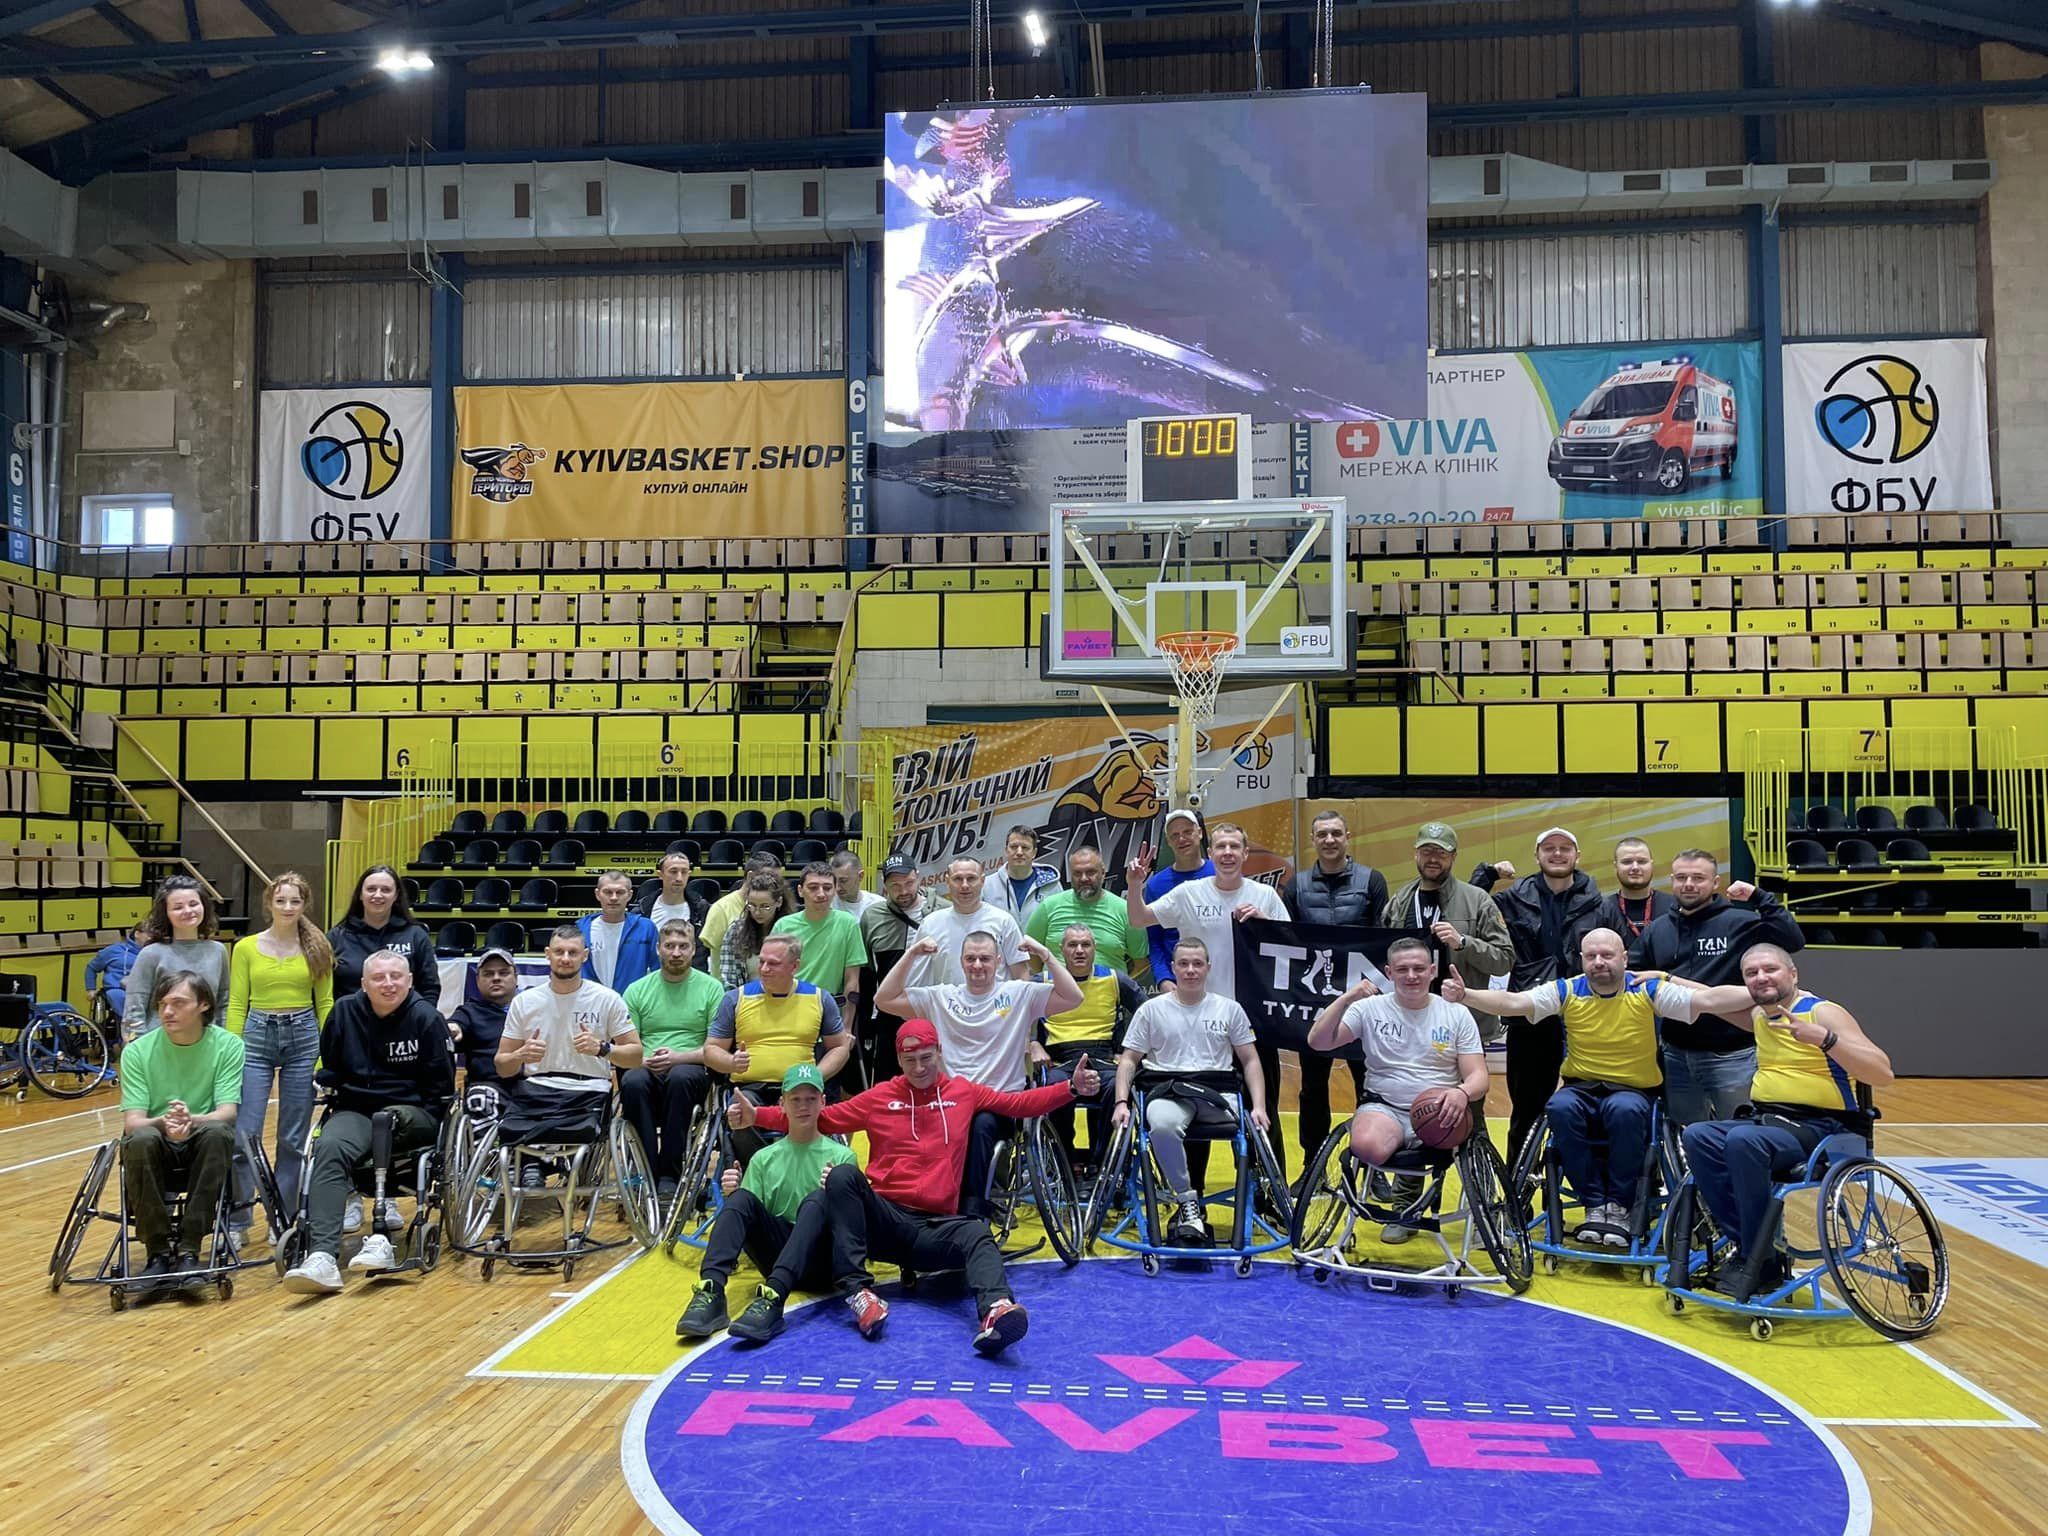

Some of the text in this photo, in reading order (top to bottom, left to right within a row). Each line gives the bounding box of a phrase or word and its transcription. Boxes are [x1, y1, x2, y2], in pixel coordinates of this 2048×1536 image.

[850, 380, 866, 413] 6
[1388, 418, 1498, 456] VIVA
[1587, 424, 1611, 434] VIVA
[554, 444, 845, 473] KYIVBASKET.SHOP
[1340, 457, 1499, 478] МЕРЕЖА КЛІНІК
[10, 453, 23, 486] 6
[643, 481, 748, 494] КУПУЙ ОНЛАЙН
[851, 431, 864, 537] СЕКТОР
[1831, 476, 1937, 512] ФБУ
[1486, 512, 1510, 521] 24/7
[1657, 502, 1744, 518] viva.clinic
[1067, 642, 1108, 650] FAVBET
[1301, 634, 1329, 646] FBU
[397, 748, 409, 768] 6
[1654, 740, 1669, 761] 7
[1236, 773, 1270, 790] FBU
[676, 1389, 1773, 1481] FAVBET
